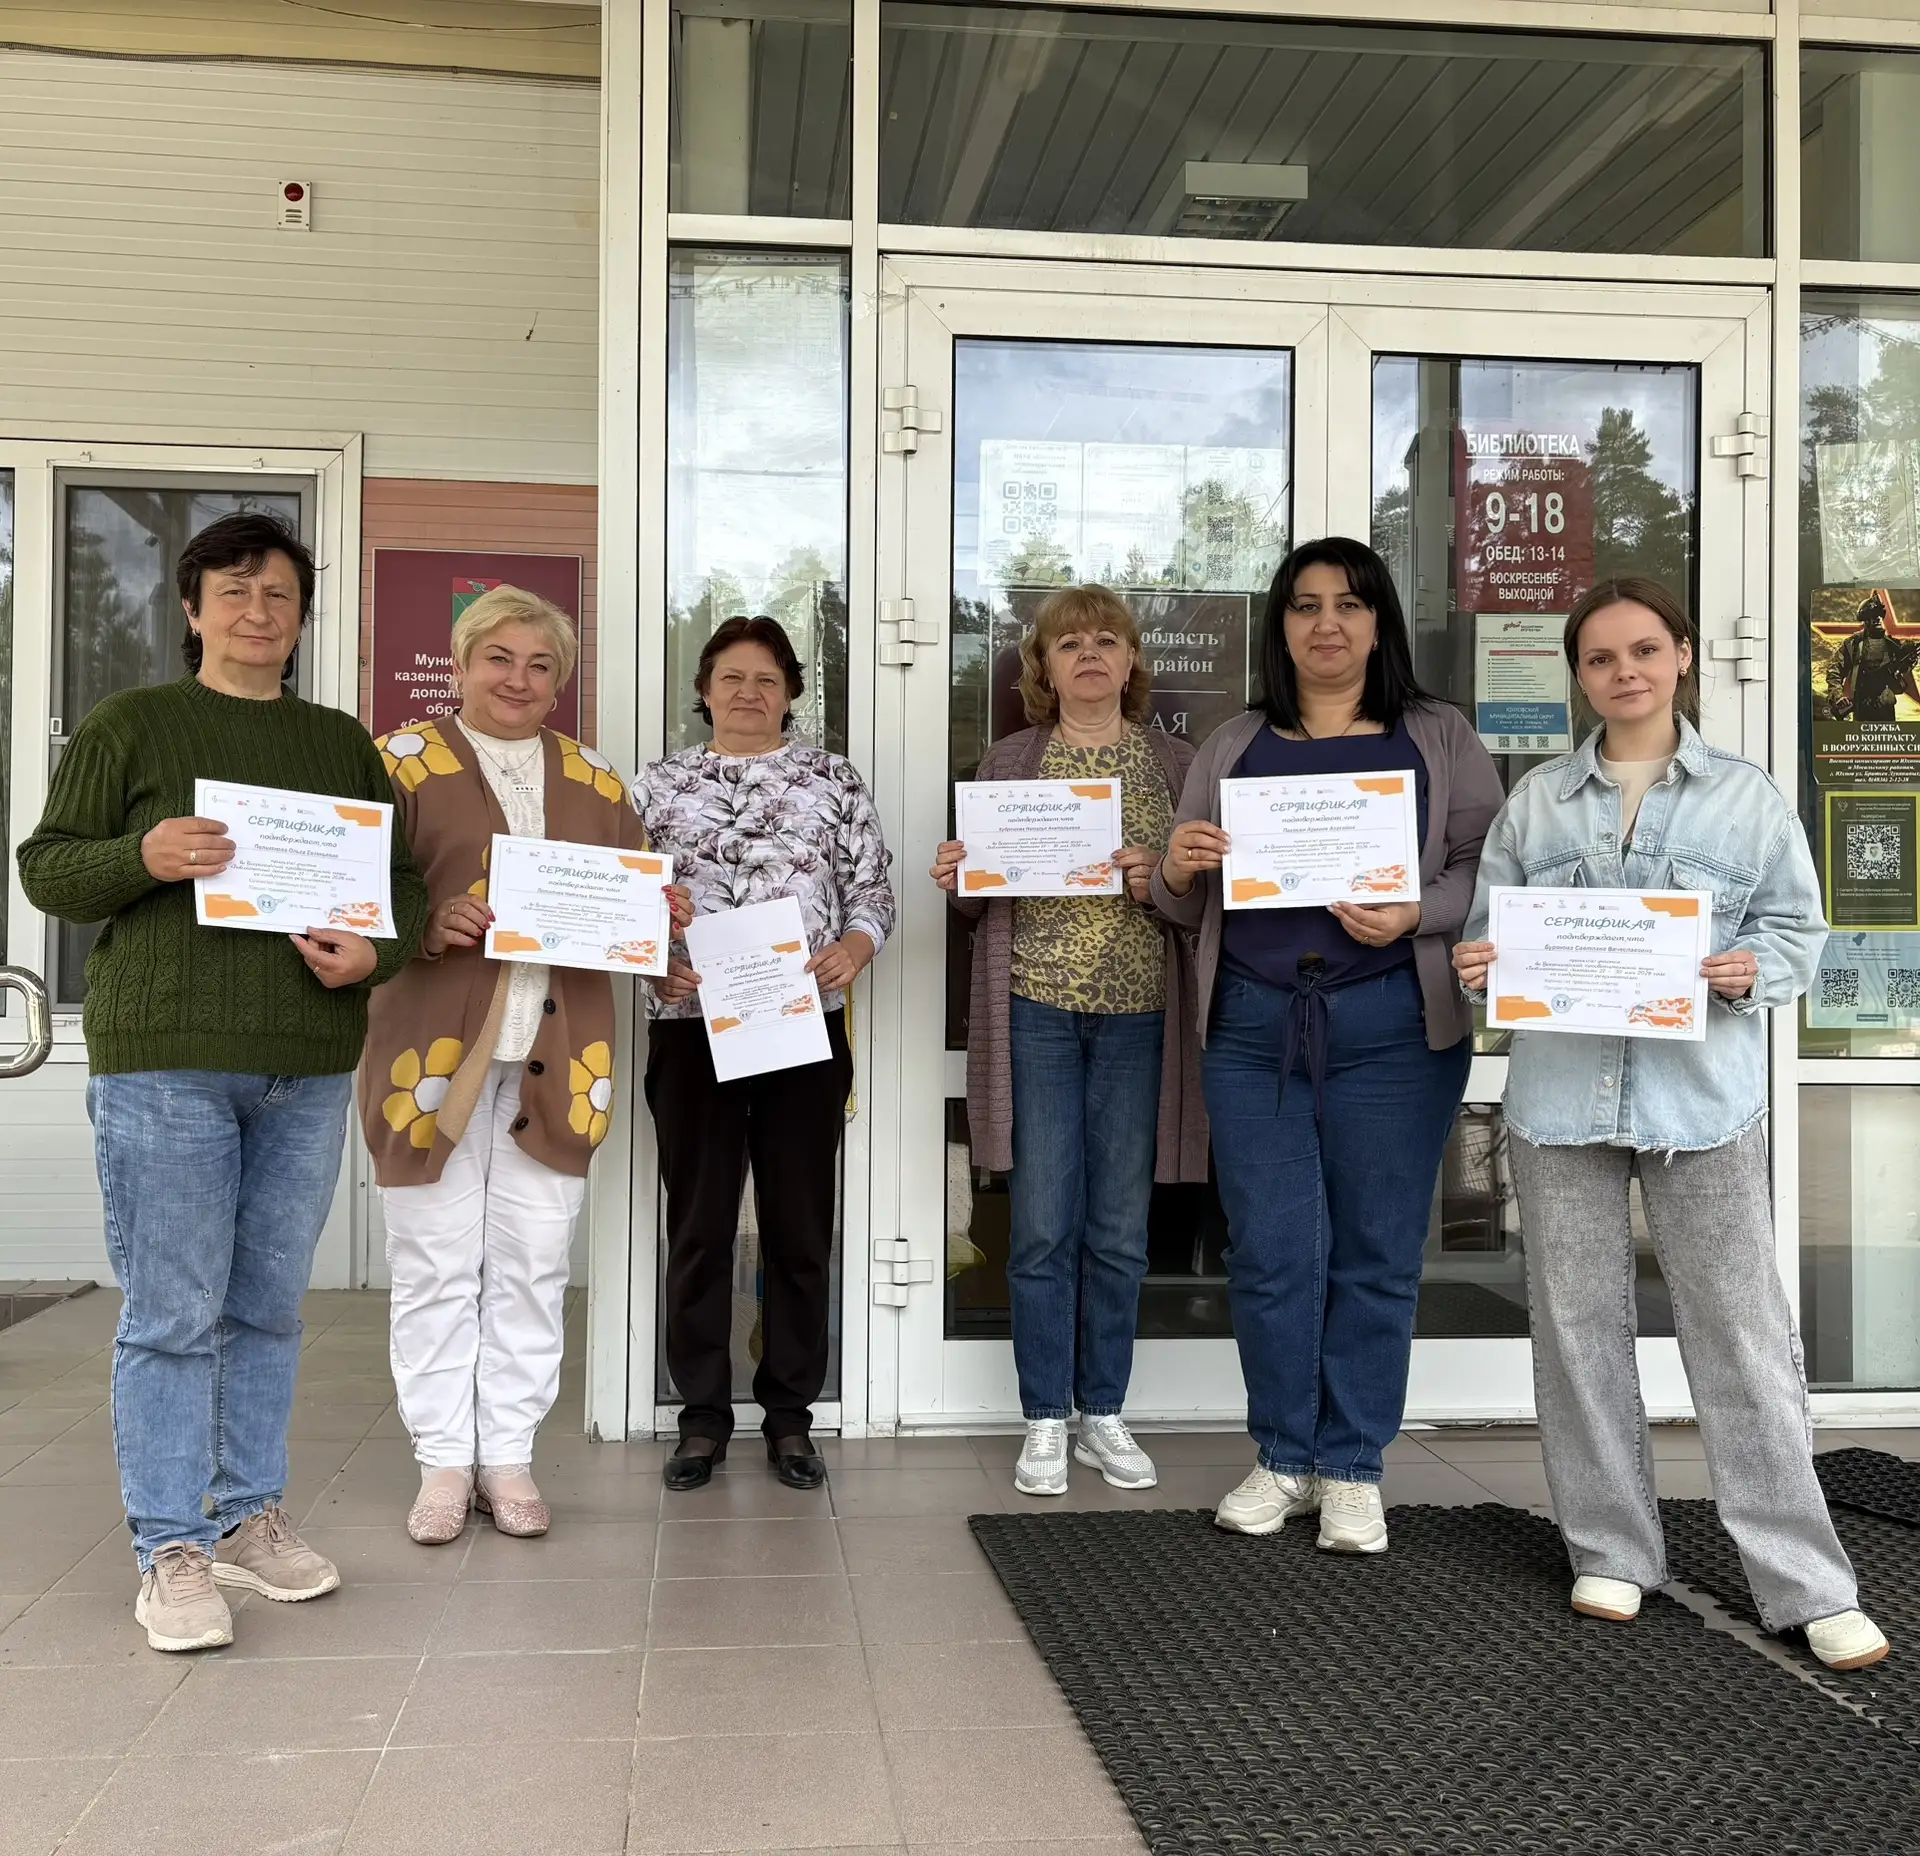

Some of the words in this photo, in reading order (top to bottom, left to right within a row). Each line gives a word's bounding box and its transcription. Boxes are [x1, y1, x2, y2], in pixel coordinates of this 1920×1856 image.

[1467, 434, 1579, 454] БИБЛИОТЕКА
[1484, 469, 1519, 481] РЕЖИМ
[1523, 469, 1564, 481] РАБОТЫ:
[1486, 492, 1565, 534] 9-18
[1486, 546, 1525, 563] ОБЕД:
[1530, 547, 1565, 560] 13-14
[1499, 587, 1554, 602] ВЫХОДНОЙ
[1141, 628, 1218, 645] область
[1153, 657, 1213, 676] район
[395, 672, 452, 682] казенно
[998, 803, 1082, 813] СЕРТИФИКАТ
[1270, 799, 1368, 812] СЕРТИФИКАТ
[248, 816, 347, 837] СЕРТИФИКАТ
[538, 865, 628, 883] СЕРТИФИКАТ
[1544, 917, 1656, 930] СЕРТИФИКАТ
[724, 956, 782, 975] СЕРТИФИКАТ
